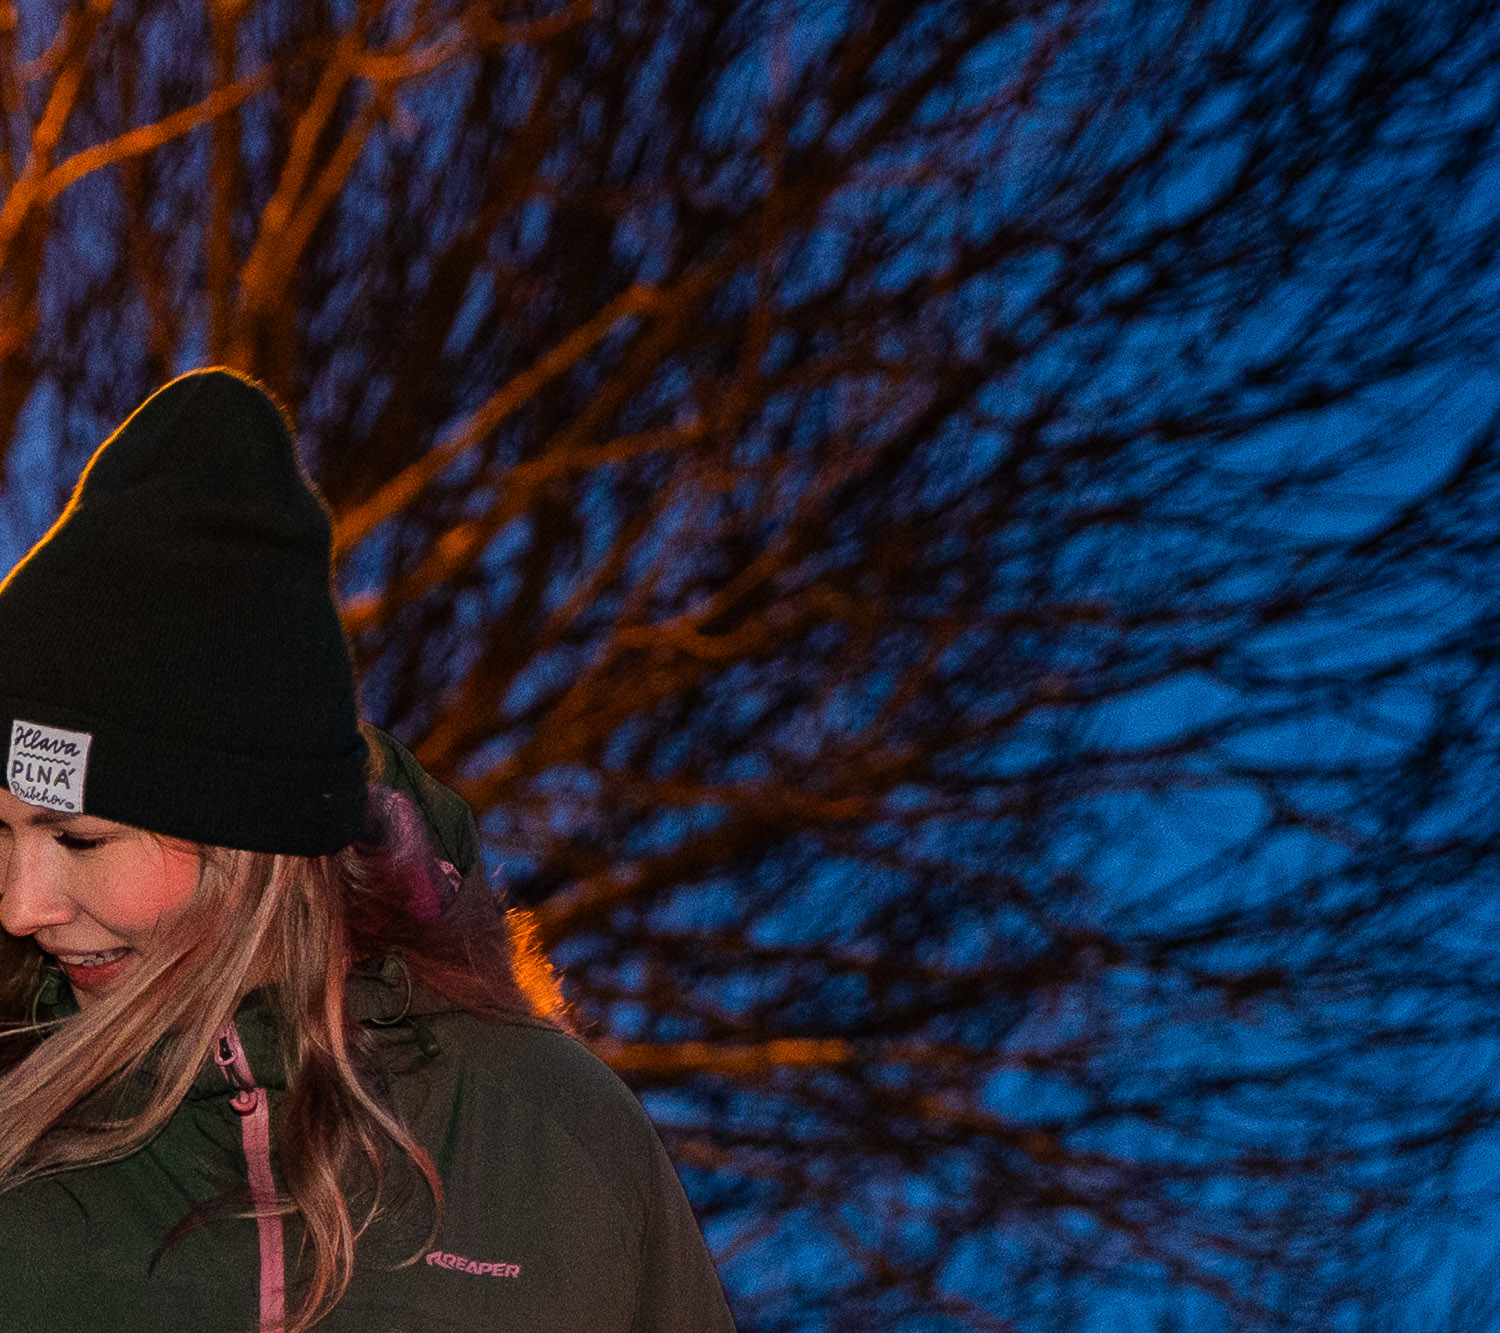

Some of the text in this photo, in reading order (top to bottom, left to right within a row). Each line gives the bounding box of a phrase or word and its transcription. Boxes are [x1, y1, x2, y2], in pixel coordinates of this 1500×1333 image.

[14, 726, 81, 757] Hlava
[11, 760, 76, 790] PLNÁ
[441, 1252, 522, 1278] REAPER
